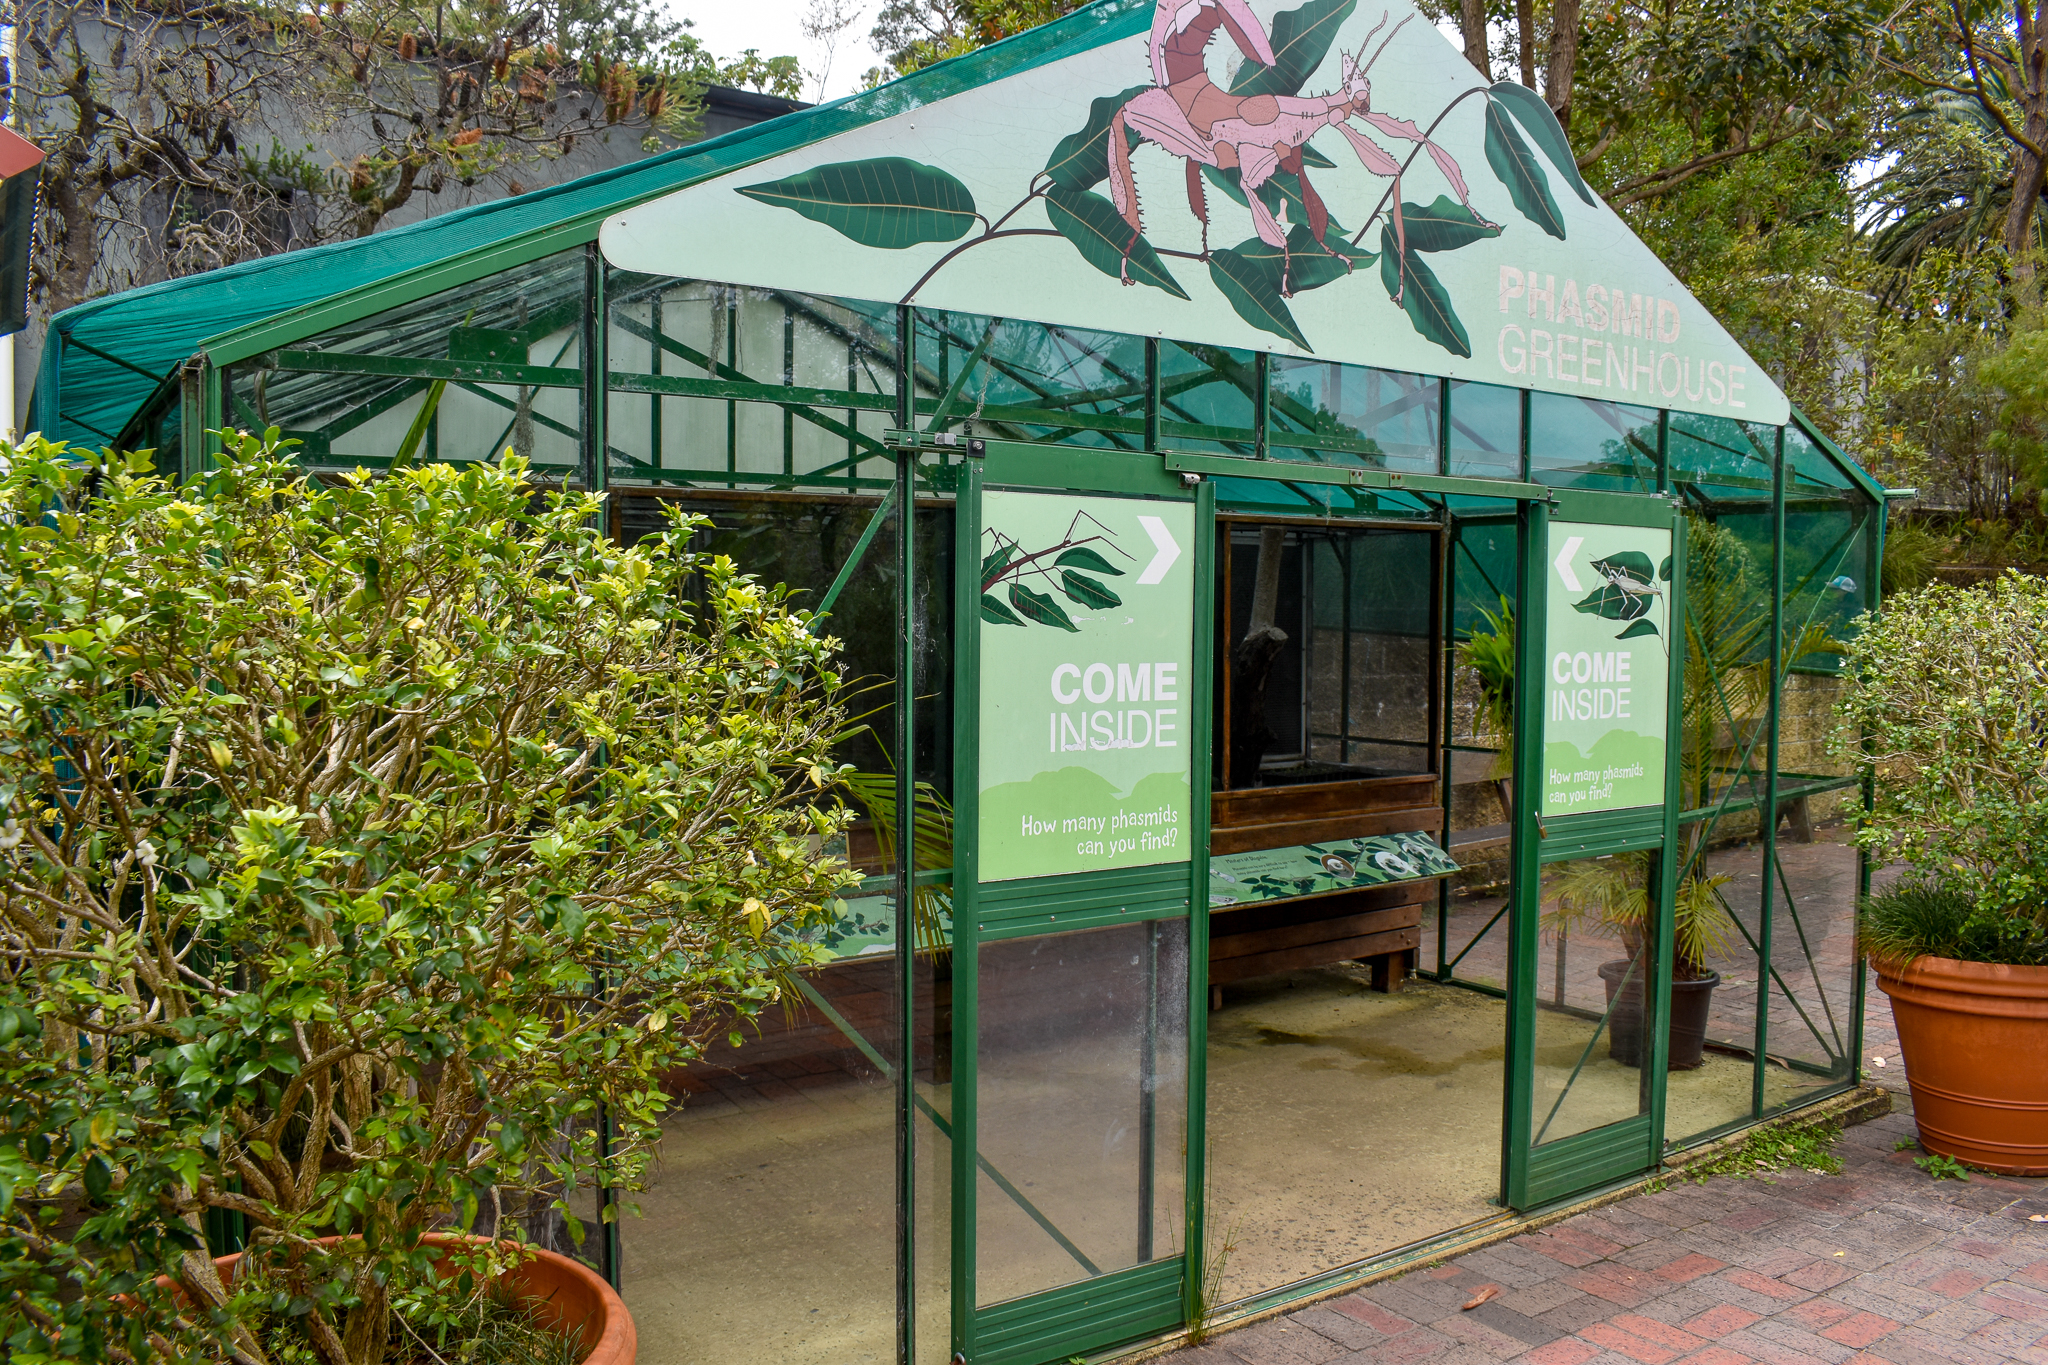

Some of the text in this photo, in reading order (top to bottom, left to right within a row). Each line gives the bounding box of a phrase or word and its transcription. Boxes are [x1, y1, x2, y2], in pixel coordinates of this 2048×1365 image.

[1499, 264, 1681, 344] PHASMID
[1498, 323, 1747, 408] GREENHOUSE
[1050, 662, 1178, 704] COME
[1552, 651, 1631, 684] COME
[1552, 687, 1631, 721] INSIDE
[1050, 708, 1177, 752] INSIDE
[1549, 761, 1644, 785] How many phasmids
[1549, 782, 1613, 806] can you find?
[1021, 803, 1178, 837] How many phasmids
[1077, 827, 1178, 859] can you find?
